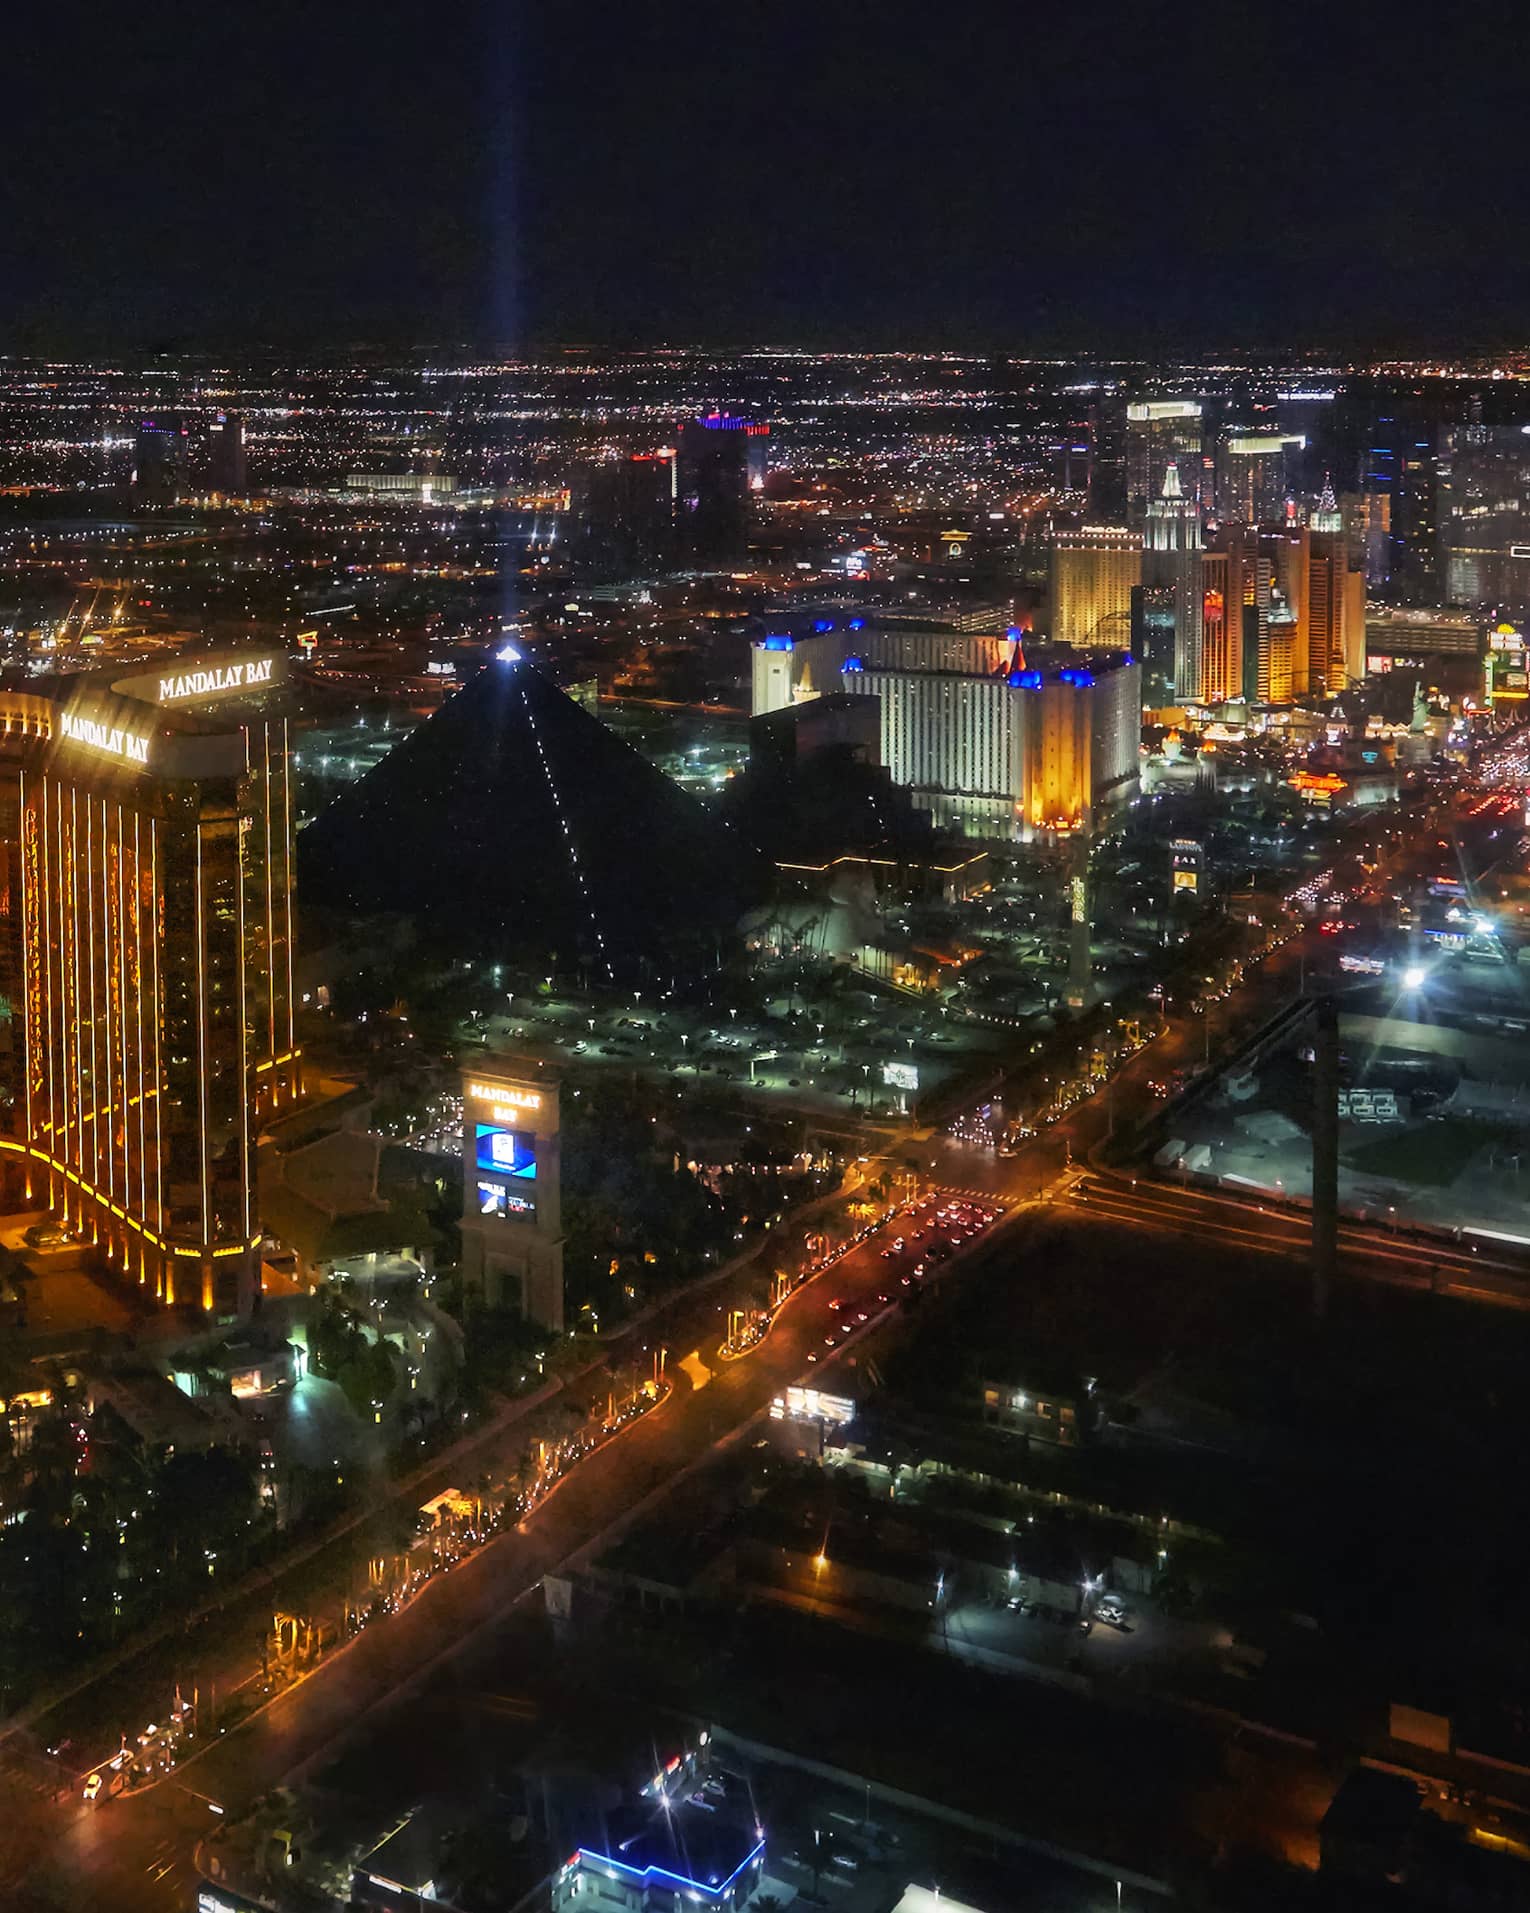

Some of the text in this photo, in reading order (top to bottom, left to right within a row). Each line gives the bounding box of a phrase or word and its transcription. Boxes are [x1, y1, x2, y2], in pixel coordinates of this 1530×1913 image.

[159, 659, 273, 701] MANDALAY BAY
[60, 712, 150, 764] MANDALAY BAY
[471, 1084, 541, 1109] MANDALAY
